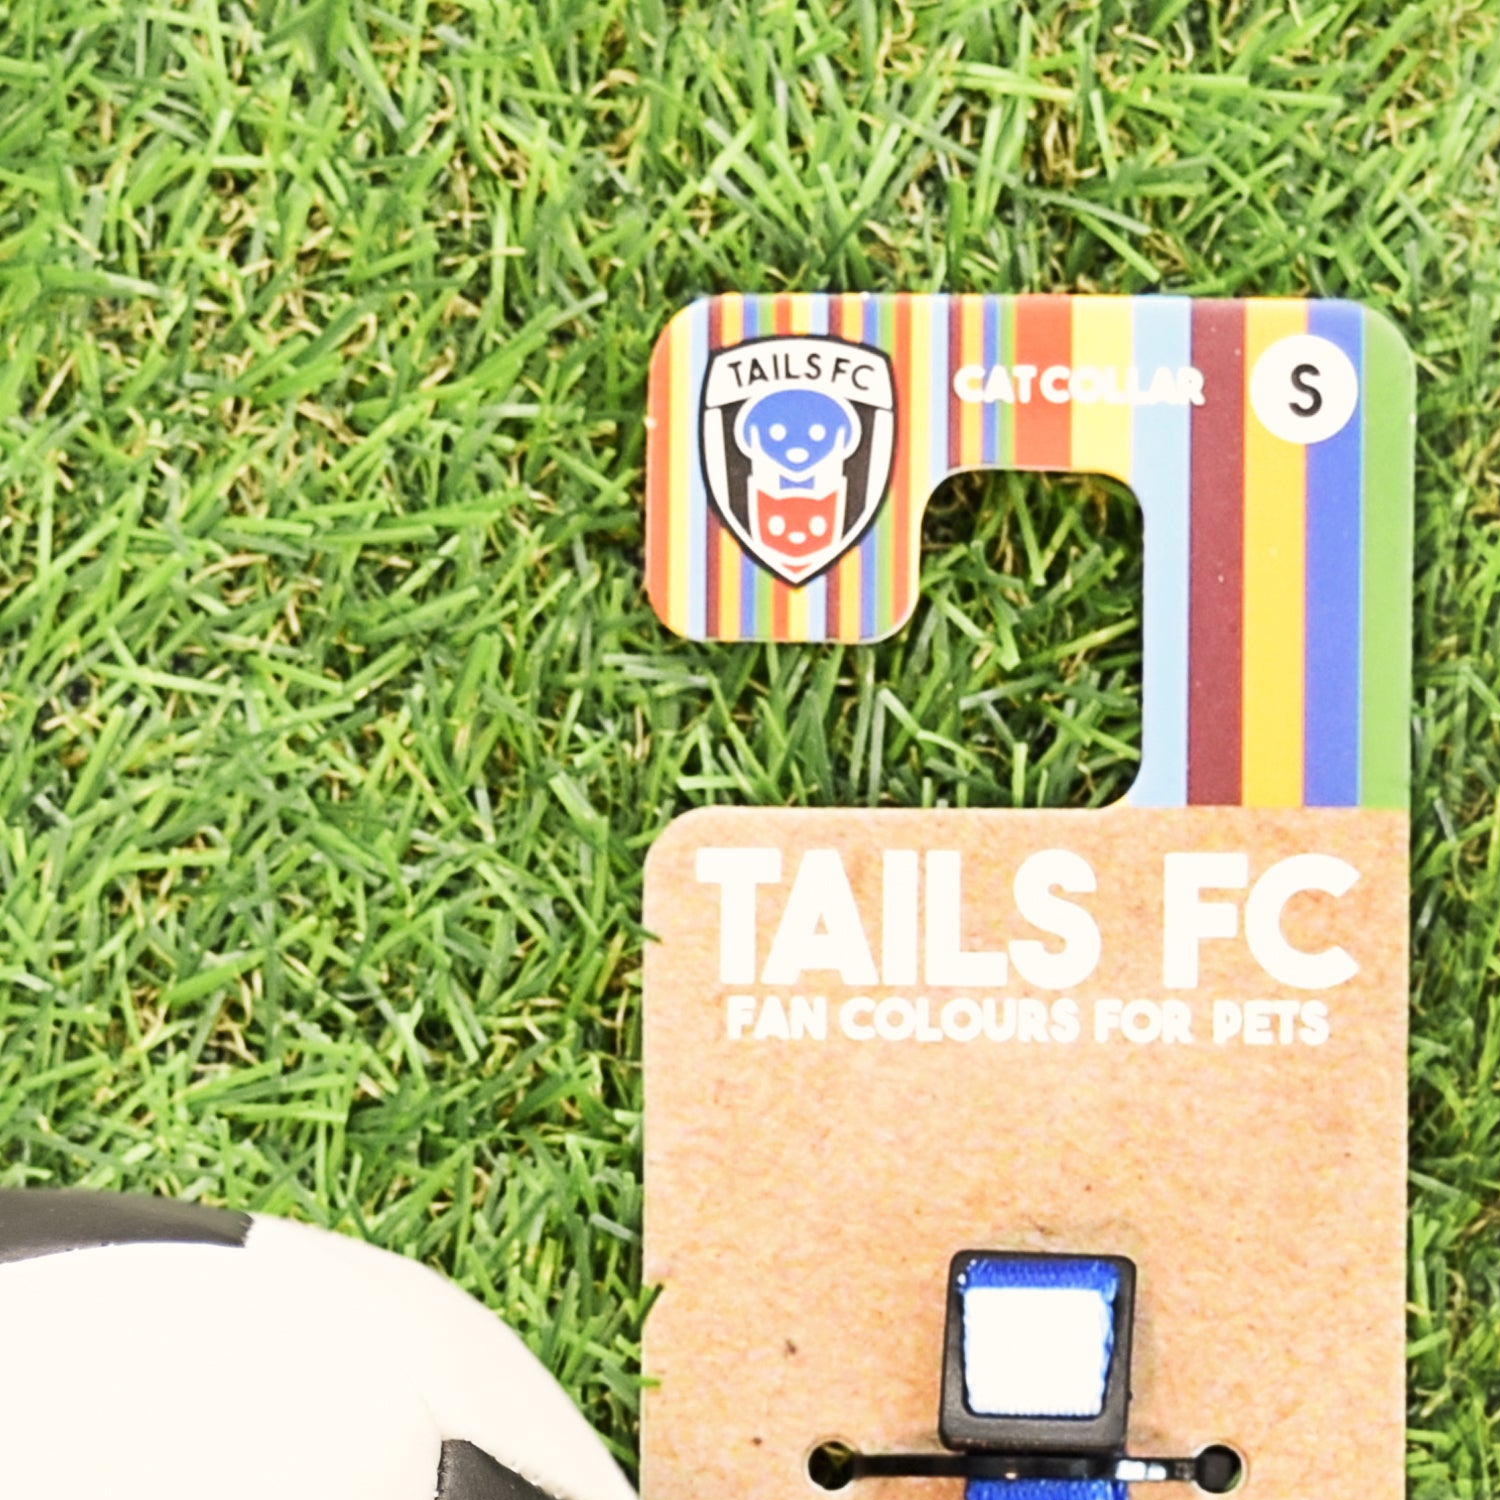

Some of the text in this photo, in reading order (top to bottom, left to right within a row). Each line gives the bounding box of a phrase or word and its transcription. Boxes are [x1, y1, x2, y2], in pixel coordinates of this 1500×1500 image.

[727, 353, 876, 391] TAILS FC
[953, 364, 1206, 406] CAT COLLAR
[1290, 364, 1322, 418] S
[695, 847, 1361, 990] TAILS FC
[726, 995, 1331, 1046] FAN COLOURS FOR PETS
